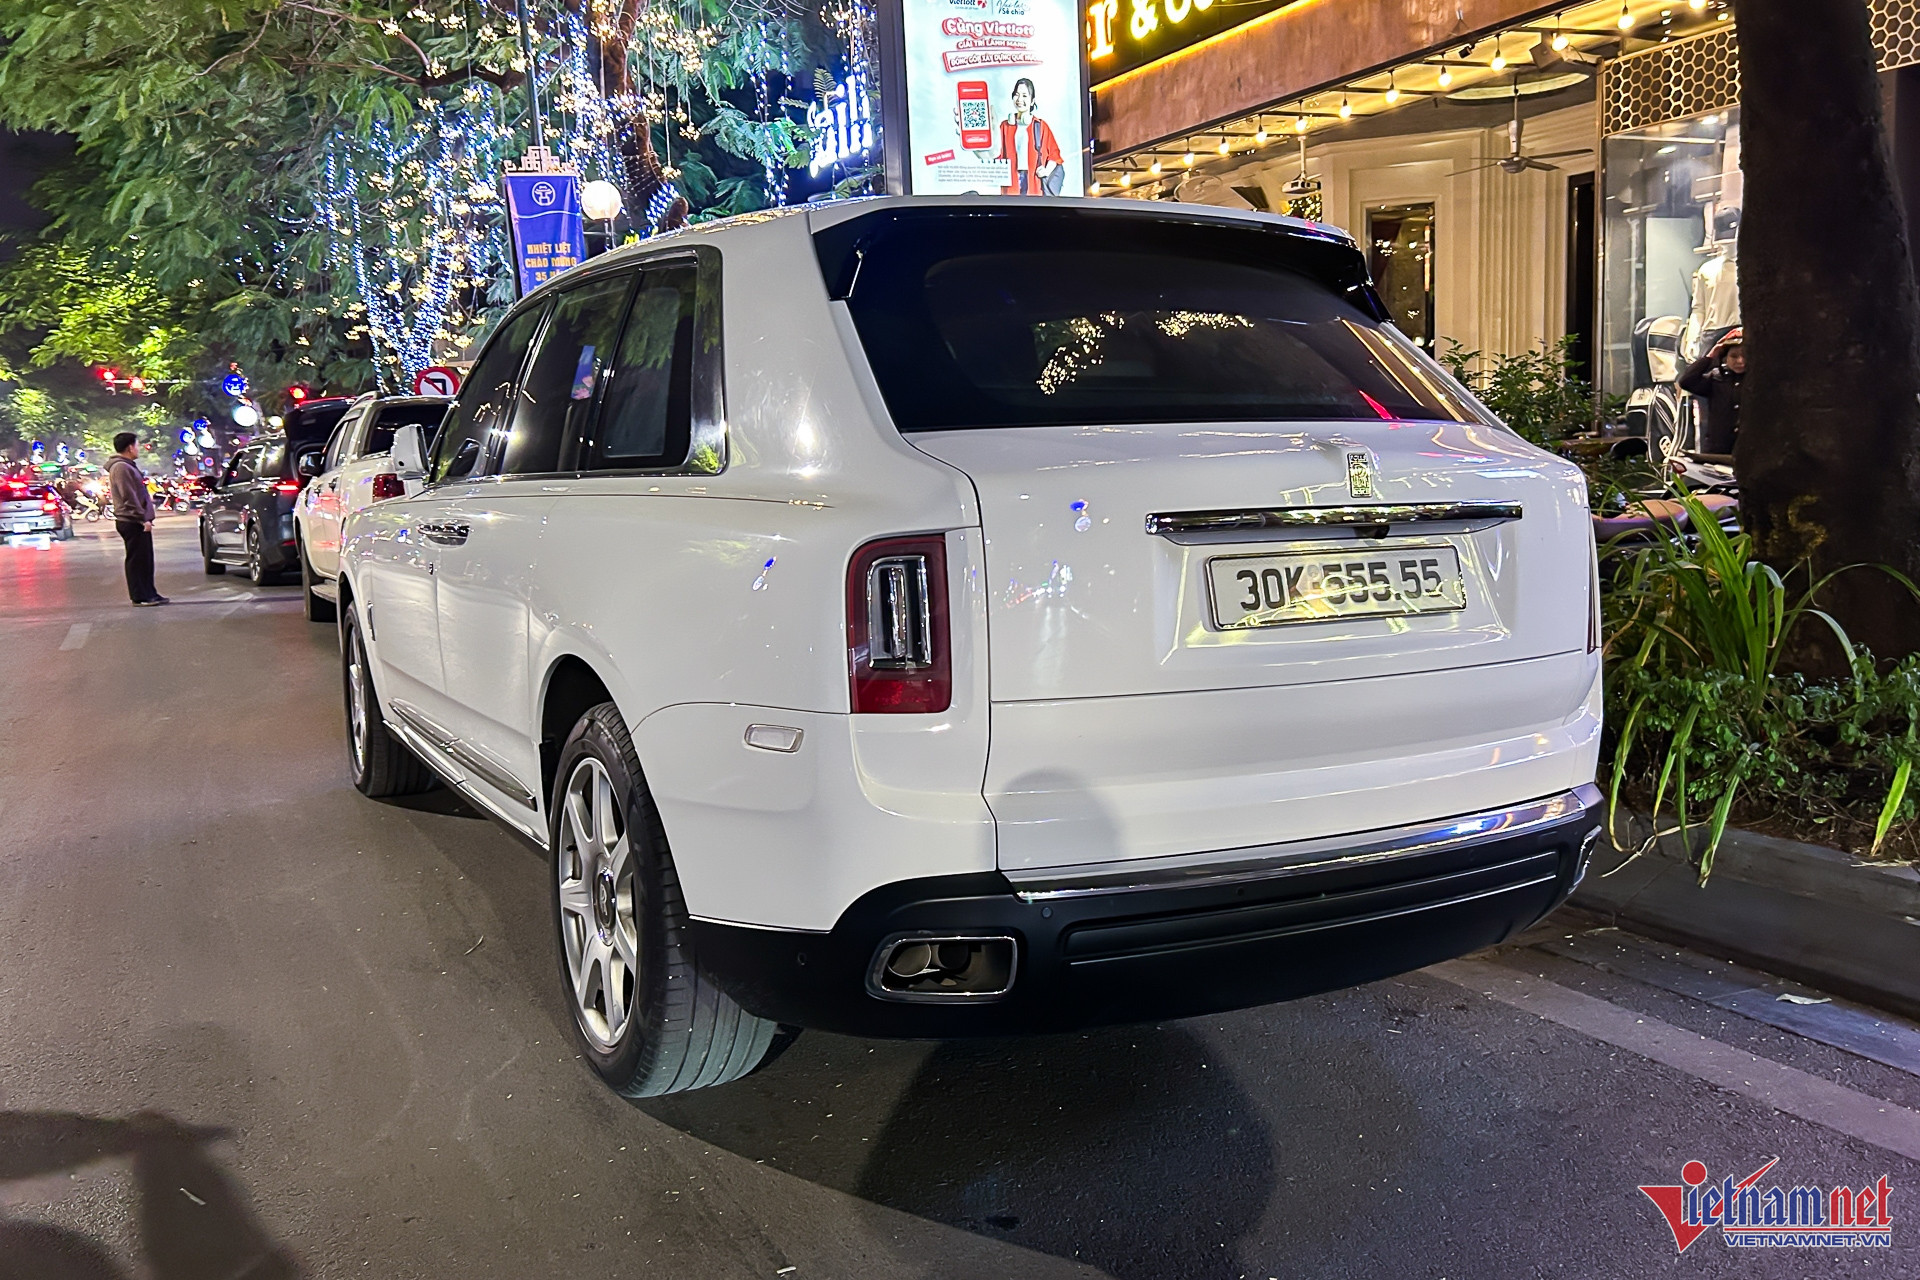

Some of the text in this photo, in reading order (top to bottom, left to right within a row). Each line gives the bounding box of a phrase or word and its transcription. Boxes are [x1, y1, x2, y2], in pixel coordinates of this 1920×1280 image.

[945, 18, 1034, 38] Cùng Vietlott
[526, 241, 571, 255] NHIỆT LIỆT
[525, 256, 549, 268] CHÀO
[535, 271, 548, 282] 35
